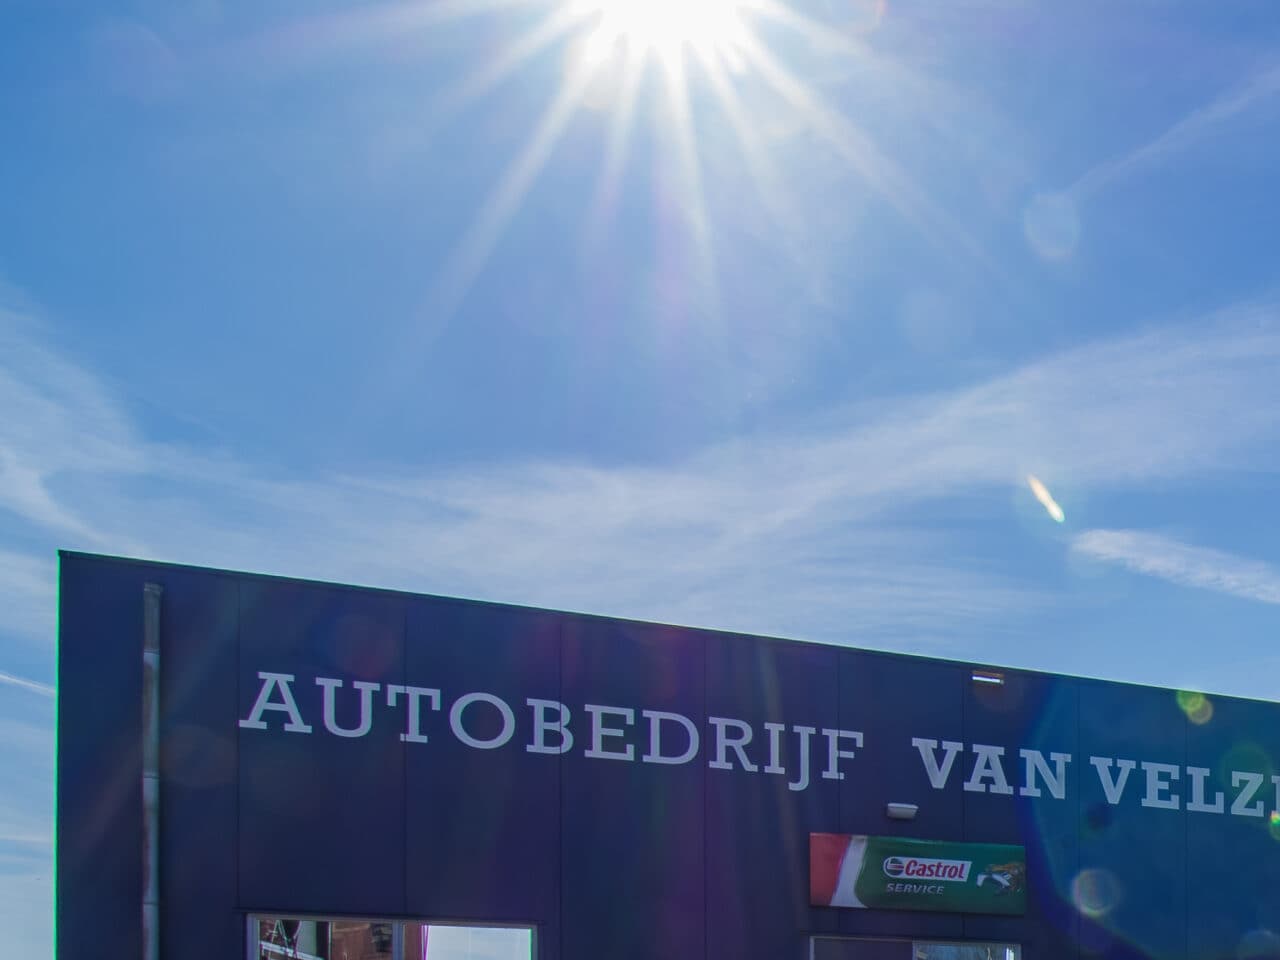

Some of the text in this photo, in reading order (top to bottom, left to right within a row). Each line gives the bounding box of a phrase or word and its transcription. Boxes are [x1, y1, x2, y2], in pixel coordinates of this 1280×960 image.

[239, 671, 865, 791] AUTOBEDRIJF
[911, 737, 1072, 800] VAN
[905, 859, 965, 879] Castrol
[886, 882, 945, 895] SERVICE
